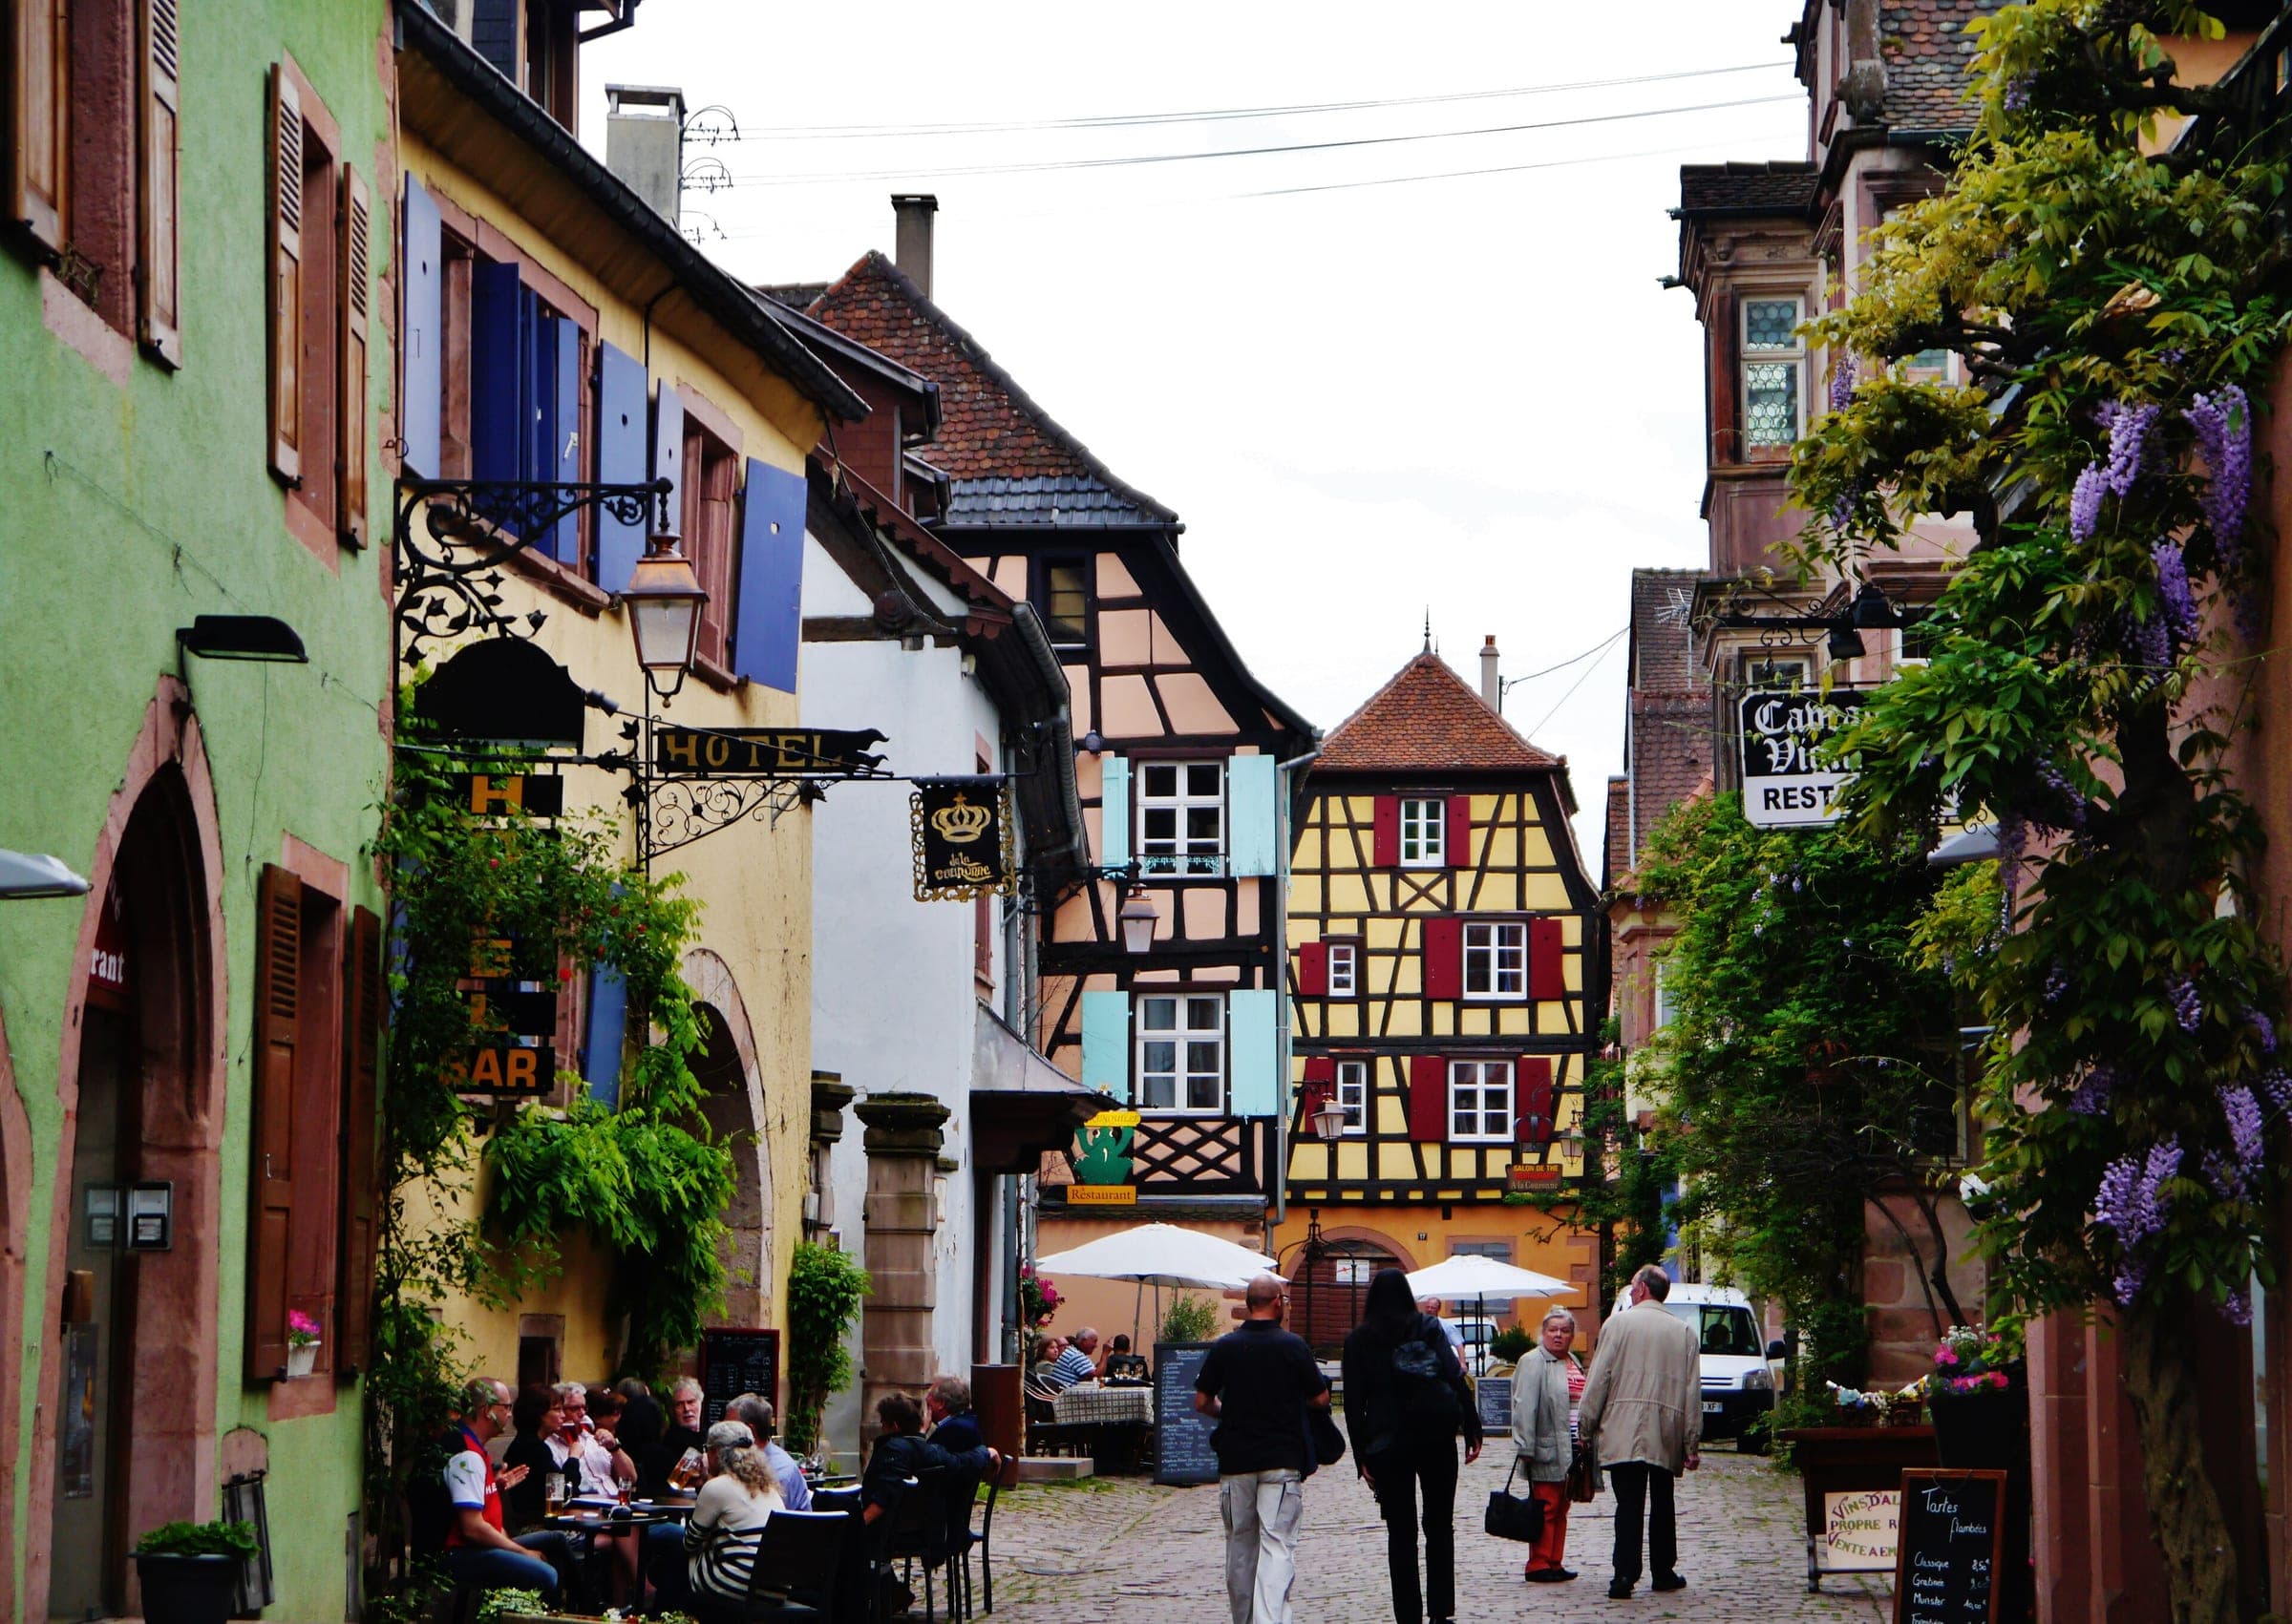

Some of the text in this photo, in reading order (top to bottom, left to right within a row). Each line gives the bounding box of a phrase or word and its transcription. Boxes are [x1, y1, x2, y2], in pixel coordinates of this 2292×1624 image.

[665, 733, 843, 768] HOTEL
[90, 947, 125, 984] rant
[1071, 1188, 1131, 1200] Restaurant
[1832, 1496, 1868, 1520] VINS
[1921, 1486, 1958, 1513] Tartes
[1831, 1519, 1881, 1530] PROPRE
[1828, 1530, 1868, 1556] VENTE
[1915, 1550, 1949, 1571] Classique
[1913, 1592, 1946, 1606] Munster
